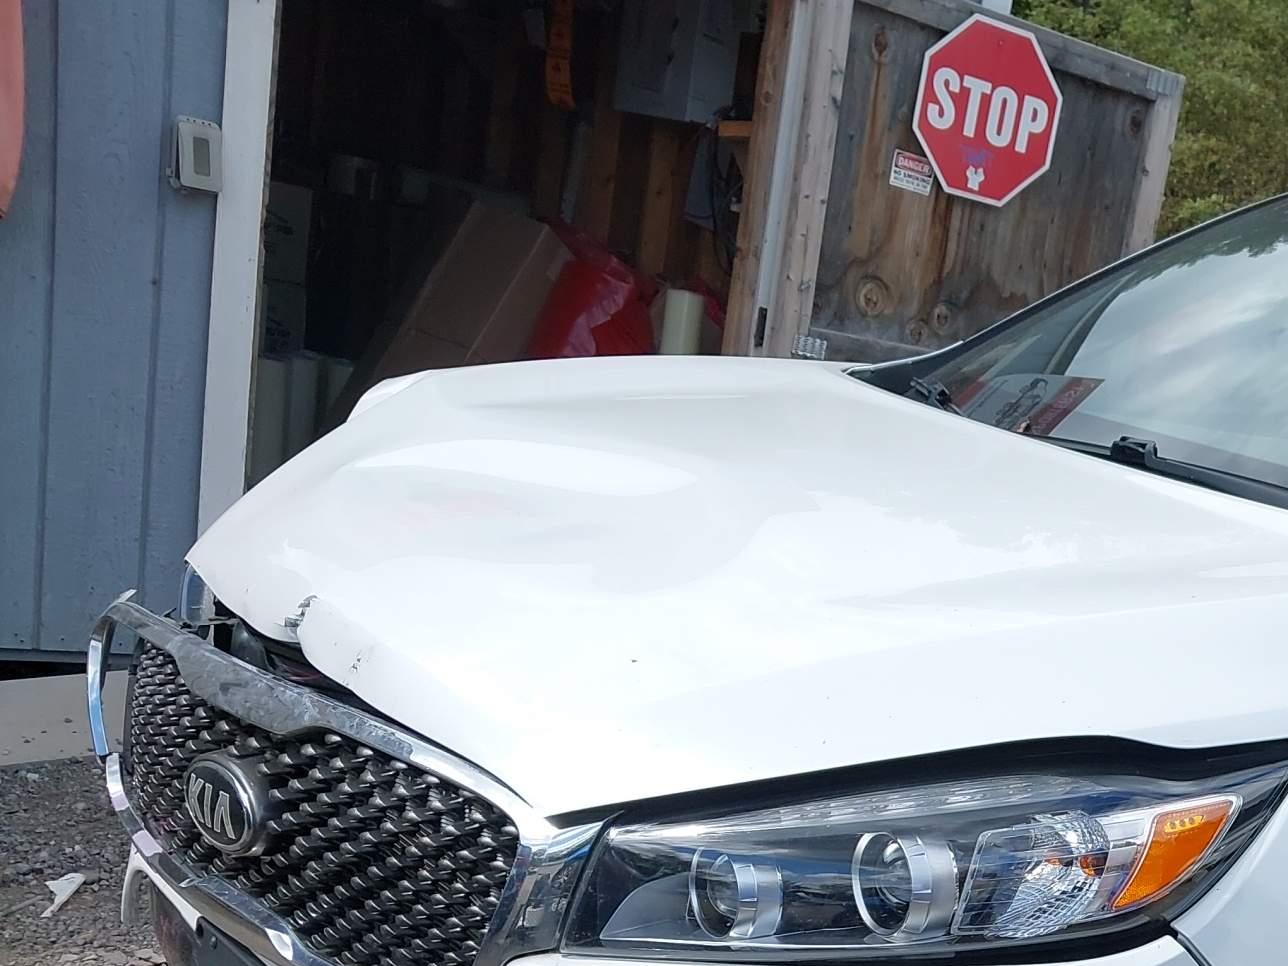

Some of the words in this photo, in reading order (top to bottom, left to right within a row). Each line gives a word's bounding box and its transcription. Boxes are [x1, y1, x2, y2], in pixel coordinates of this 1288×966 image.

[926, 66, 1049, 154] STOP
[898, 156, 931, 174] DANGER
[903, 171, 931, 185] SMOKING
[188, 772, 237, 840] KIA
